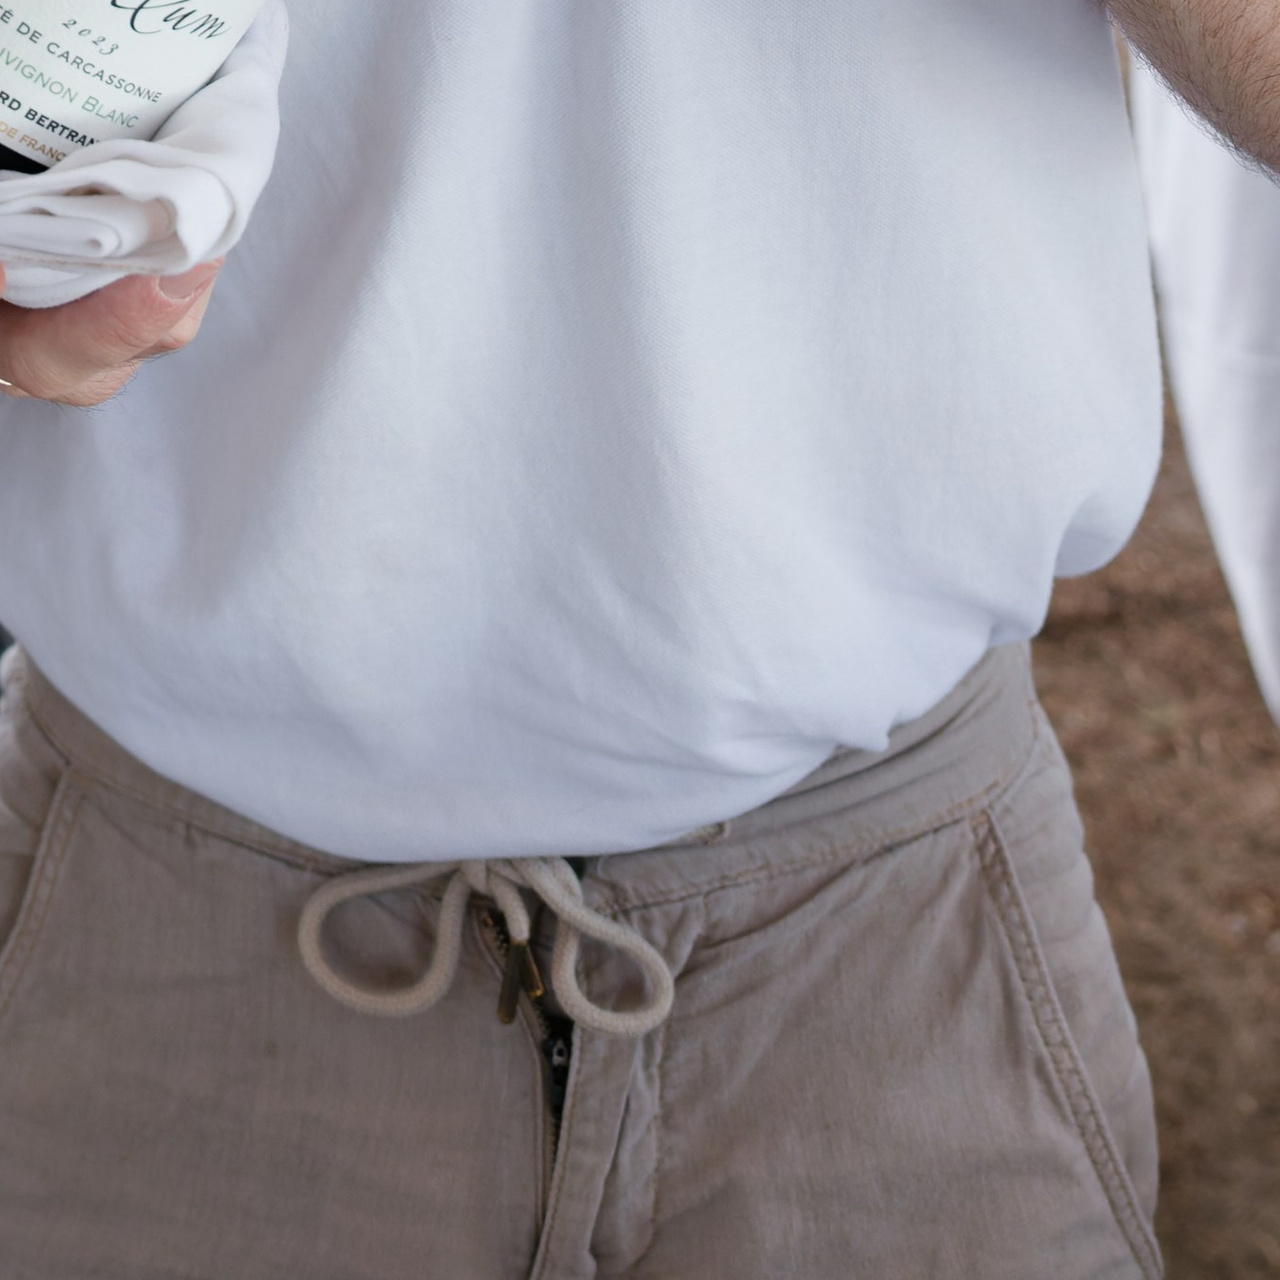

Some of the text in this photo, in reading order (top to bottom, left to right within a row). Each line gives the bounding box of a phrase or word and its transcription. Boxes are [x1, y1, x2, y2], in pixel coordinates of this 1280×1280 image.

[62, 18, 120, 56] 2023
[16, 21, 43, 44] DE
[46, 41, 163, 104] CARCASSONNE
[19, 134, 67, 162] FRANC
